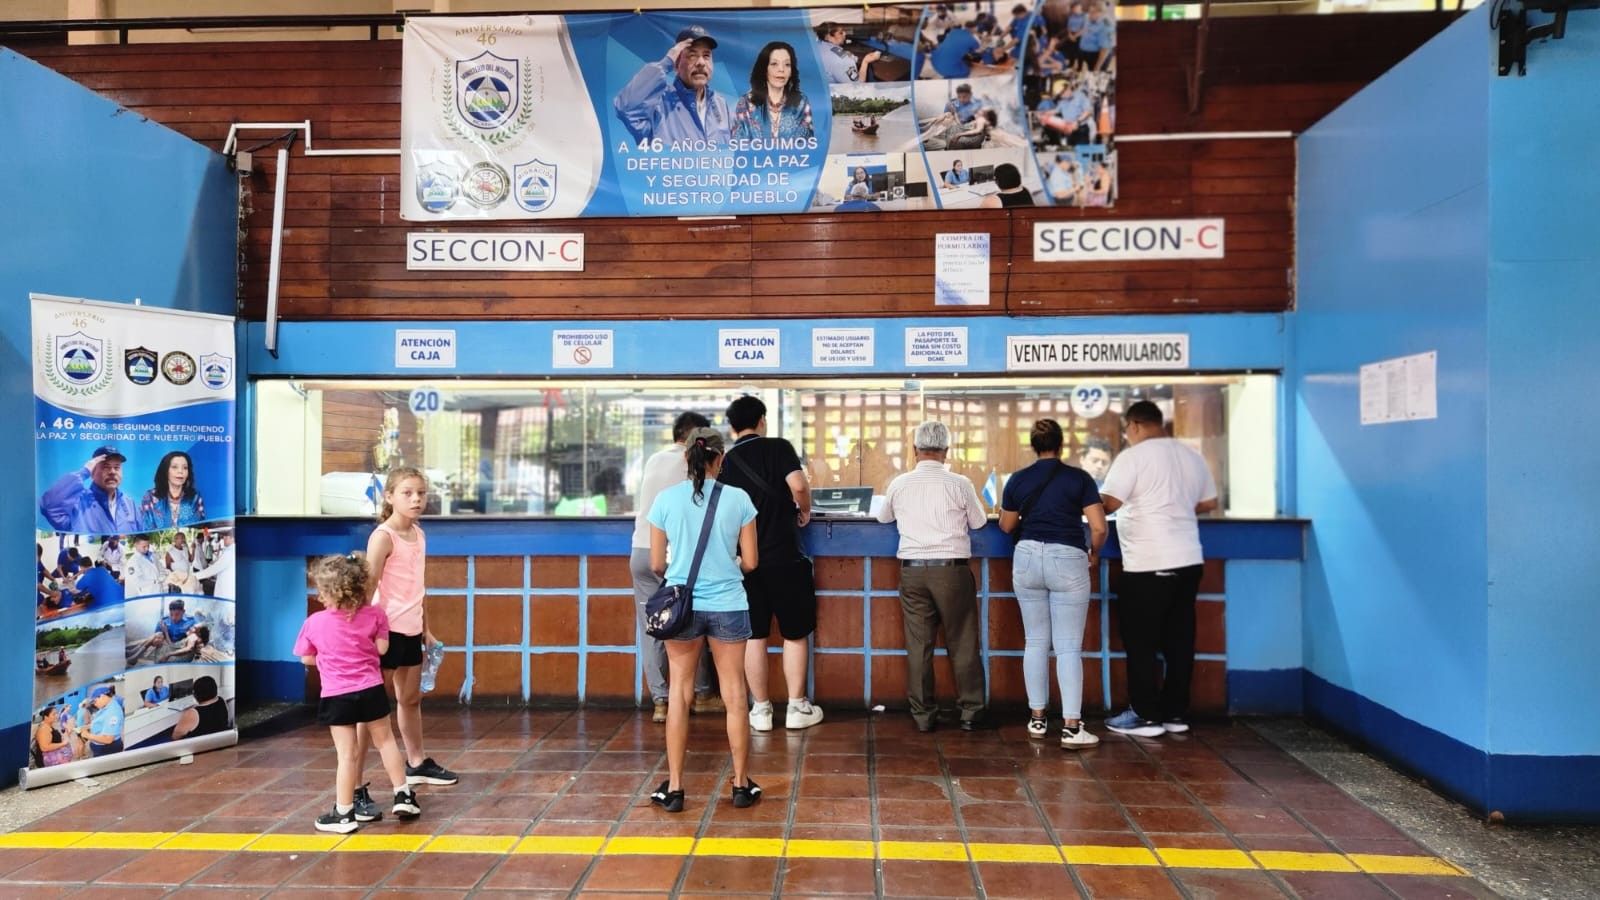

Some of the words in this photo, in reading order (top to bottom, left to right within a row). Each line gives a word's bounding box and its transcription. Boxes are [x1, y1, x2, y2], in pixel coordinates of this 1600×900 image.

[477, 33, 497, 46] 46
[618, 144, 629, 153] A
[637, 137, 663, 153] 46
[728, 137, 818, 151] SEGUIMOS
[627, 156, 748, 171] DEFENDIENDO
[753, 156, 774, 168] LA
[778, 154, 810, 168] PAZ
[646, 175, 657, 187] Y
[662, 173, 761, 187] SEGURIDAD
[767, 172, 789, 186] DE
[643, 191, 725, 205] NUESTRO
[730, 190, 798, 204] PUEBLO
[1040, 225, 1218, 252] SECCION-C
[412, 239, 579, 262] SECCION-C
[72, 318, 87, 328] 46
[401, 338, 450, 348] ATENCIÓN
[725, 336, 775, 347] ATENCIÓN
[411, 351, 440, 361] CAJA
[734, 350, 764, 360] CAJA
[1014, 345, 1057, 362] VENTA
[1062, 344, 1078, 362] DE
[1083, 342, 1181, 362] FORMULARIOS
[415, 392, 438, 411] 20
[52, 418, 75, 430] 46
[112, 424, 160, 432] SEGUIMOS
[164, 425, 224, 433] DEFENDIENDO
[80, 432, 136, 440] SEGURIDAD
[198, 435, 232, 443] PUEBLO
